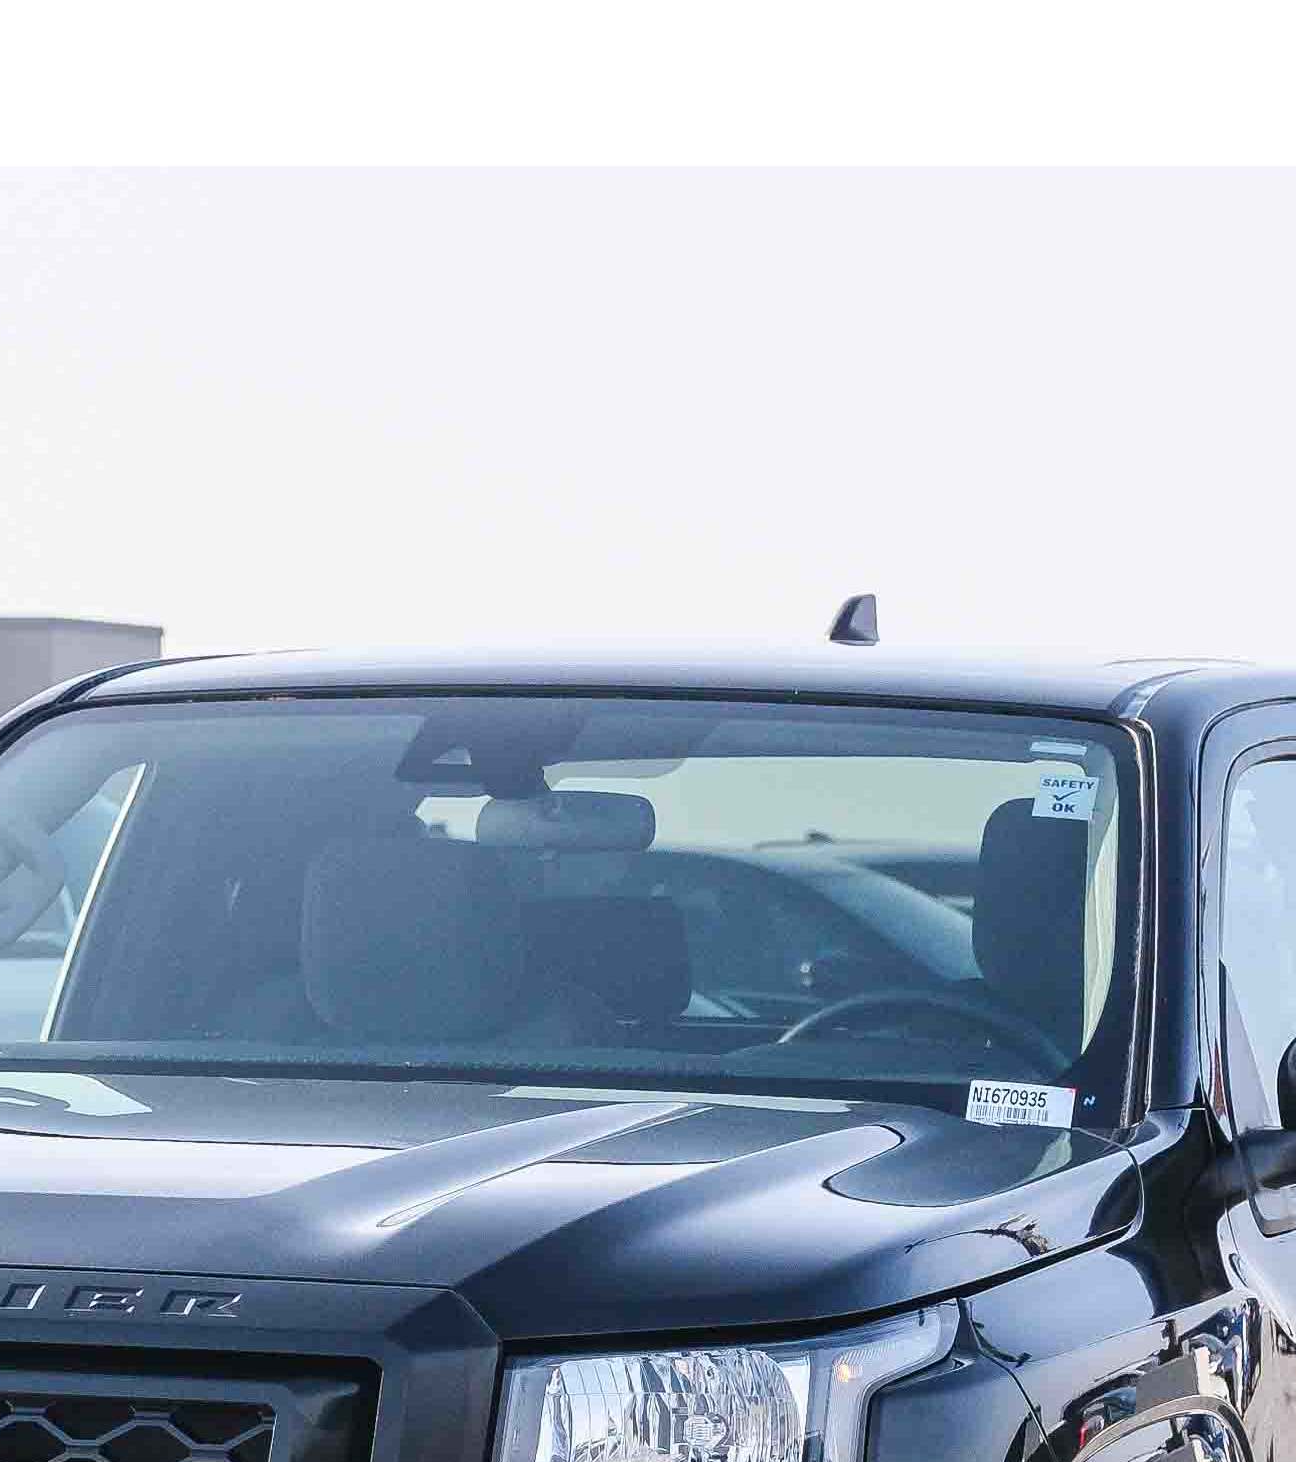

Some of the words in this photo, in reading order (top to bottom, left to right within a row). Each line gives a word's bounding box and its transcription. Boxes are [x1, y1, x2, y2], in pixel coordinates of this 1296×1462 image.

[1042, 778, 1095, 790] SAFETY
[1051, 802, 1076, 814] OK
[972, 1086, 1048, 1108] NI670935
